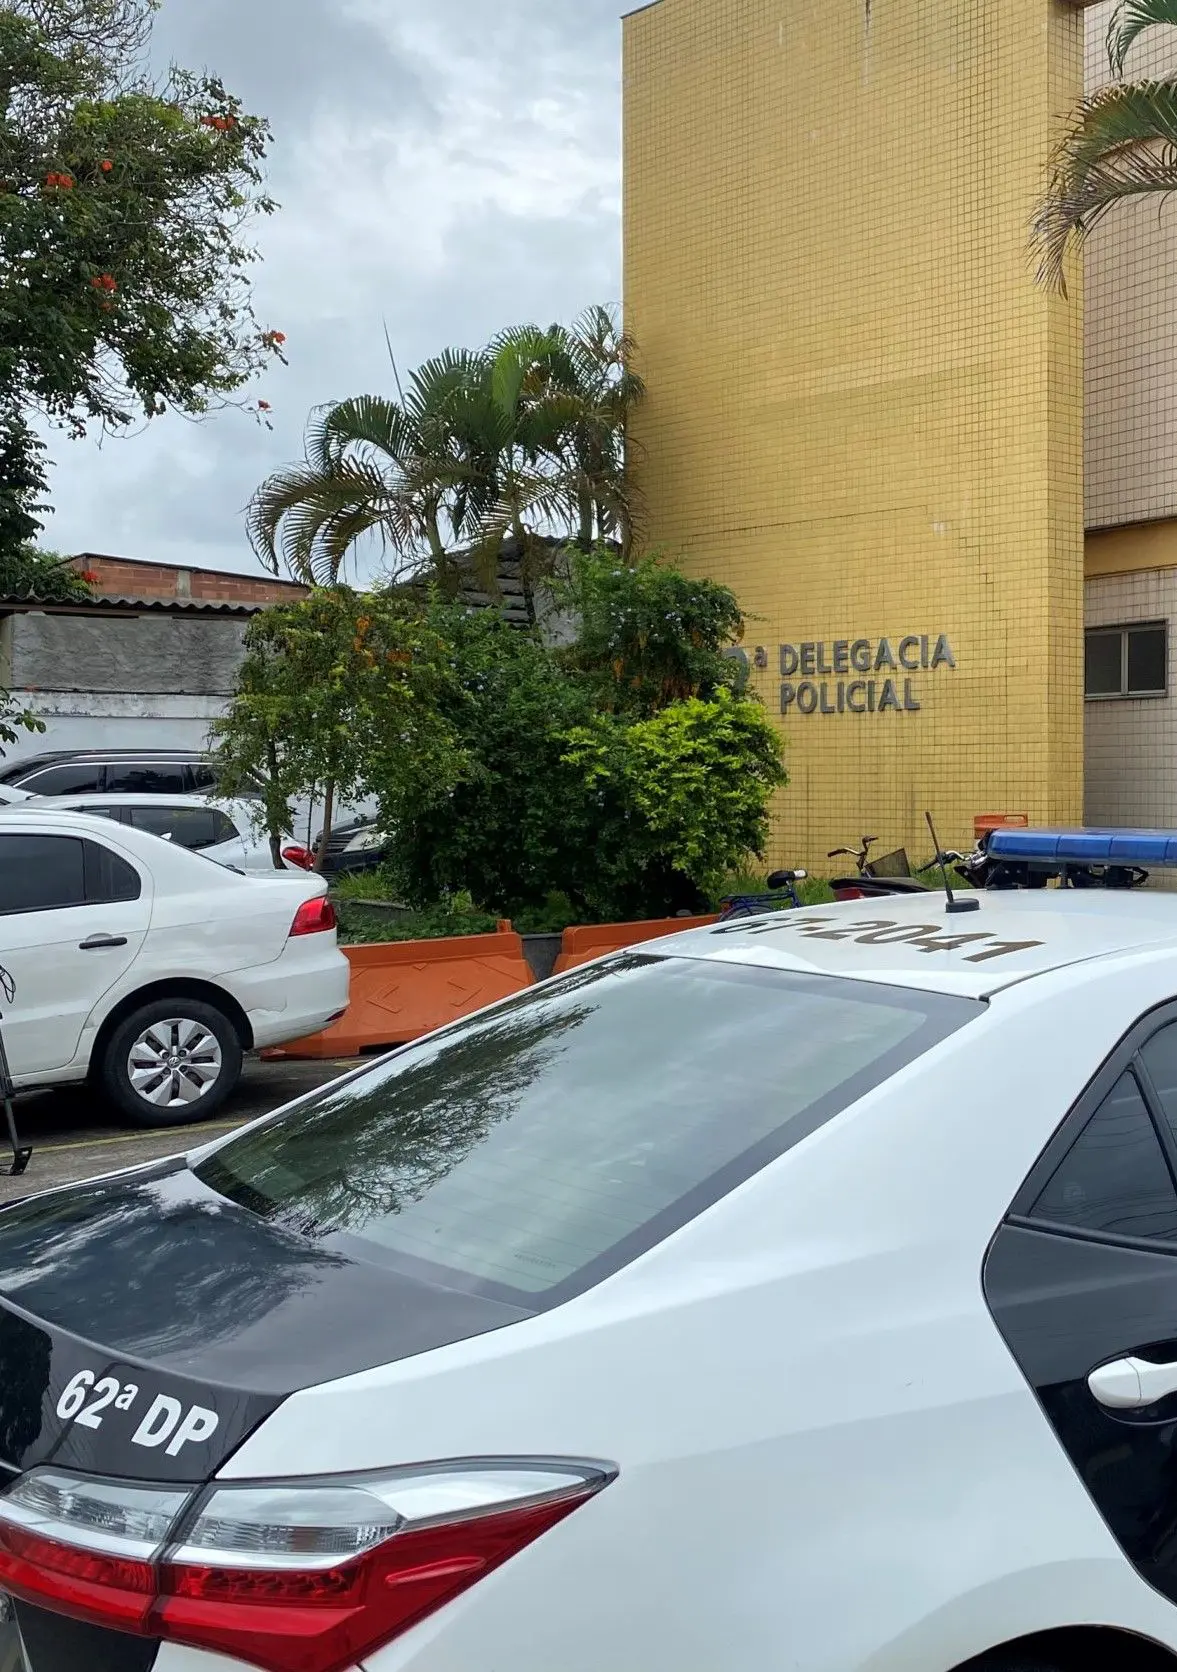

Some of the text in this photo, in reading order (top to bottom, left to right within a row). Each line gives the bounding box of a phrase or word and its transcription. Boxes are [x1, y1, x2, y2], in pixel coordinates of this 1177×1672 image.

[779, 634, 955, 675] DELEGACIA
[779, 678, 921, 714] POLICIAL
[709, 917, 1046, 963] 67-2041
[131, 1394, 219, 1456] DP
